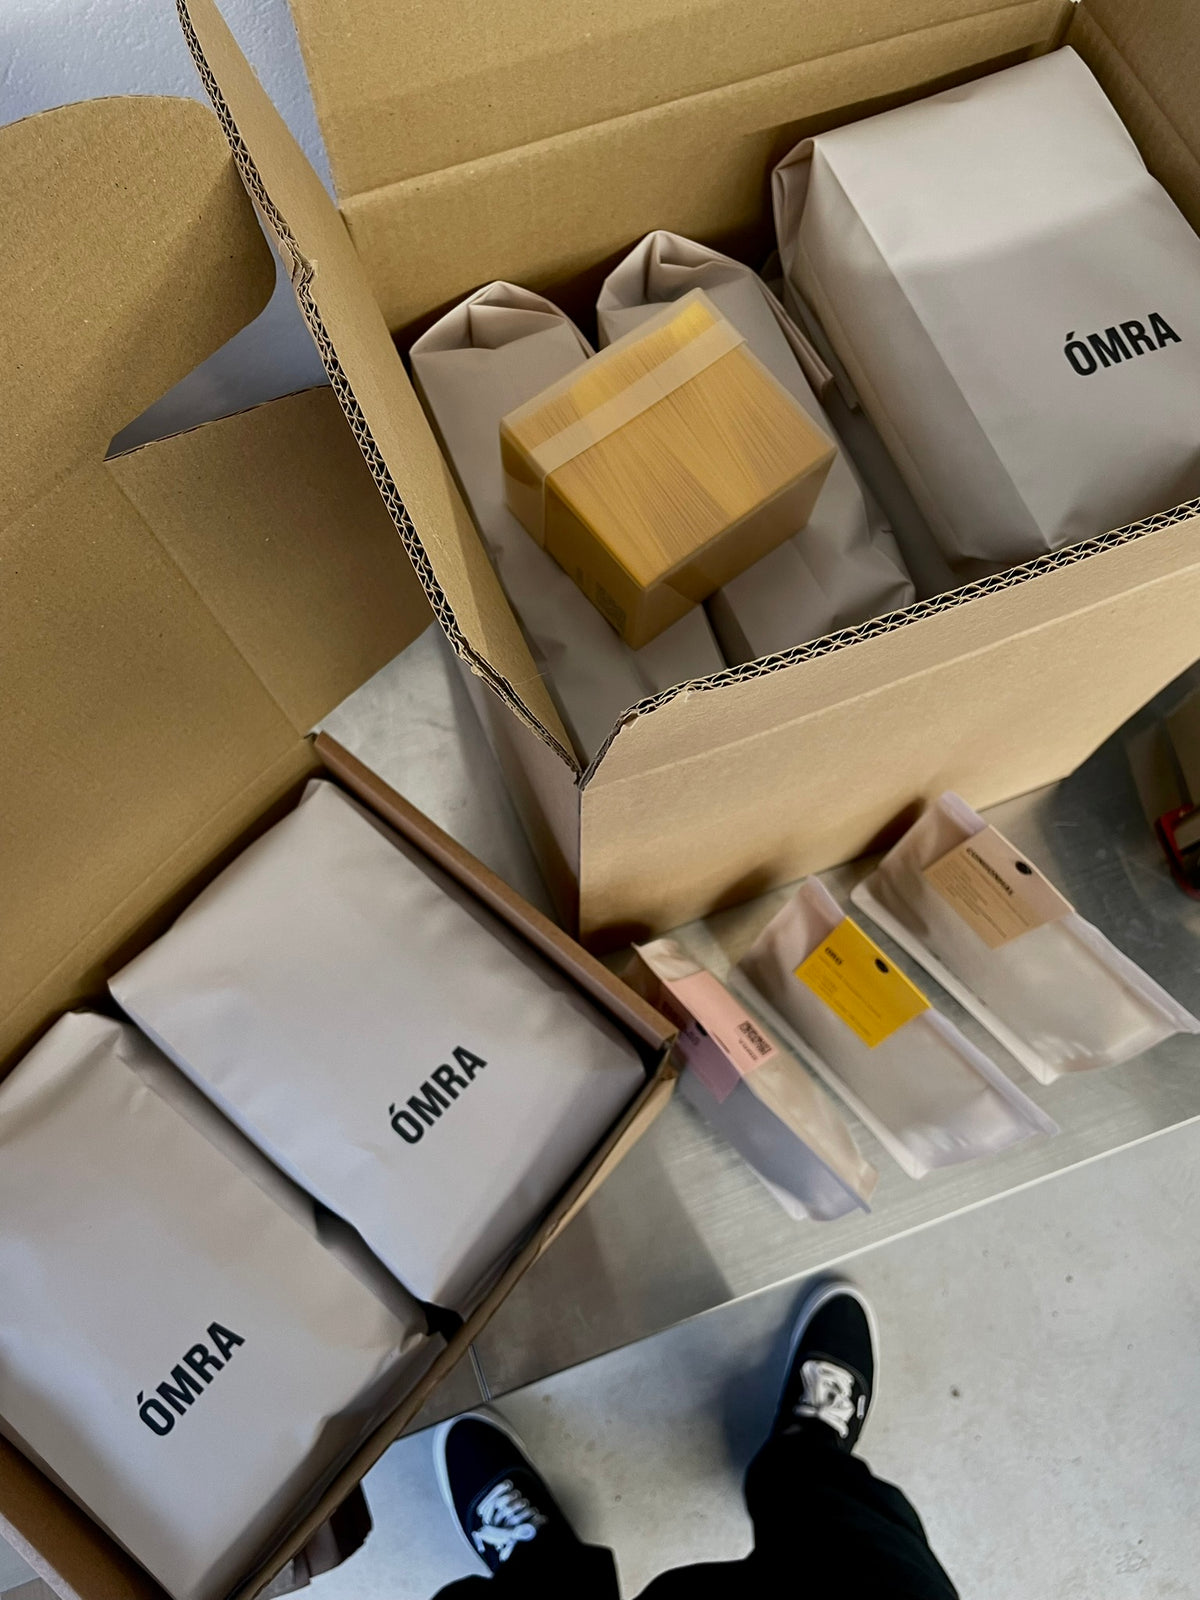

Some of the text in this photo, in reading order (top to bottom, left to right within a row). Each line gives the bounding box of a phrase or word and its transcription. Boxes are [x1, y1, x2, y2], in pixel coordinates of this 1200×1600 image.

[1064, 312, 1182, 376] ÓMRA
[389, 1045, 487, 1144] ÓMRA
[137, 1321, 246, 1437] ÓMRA
